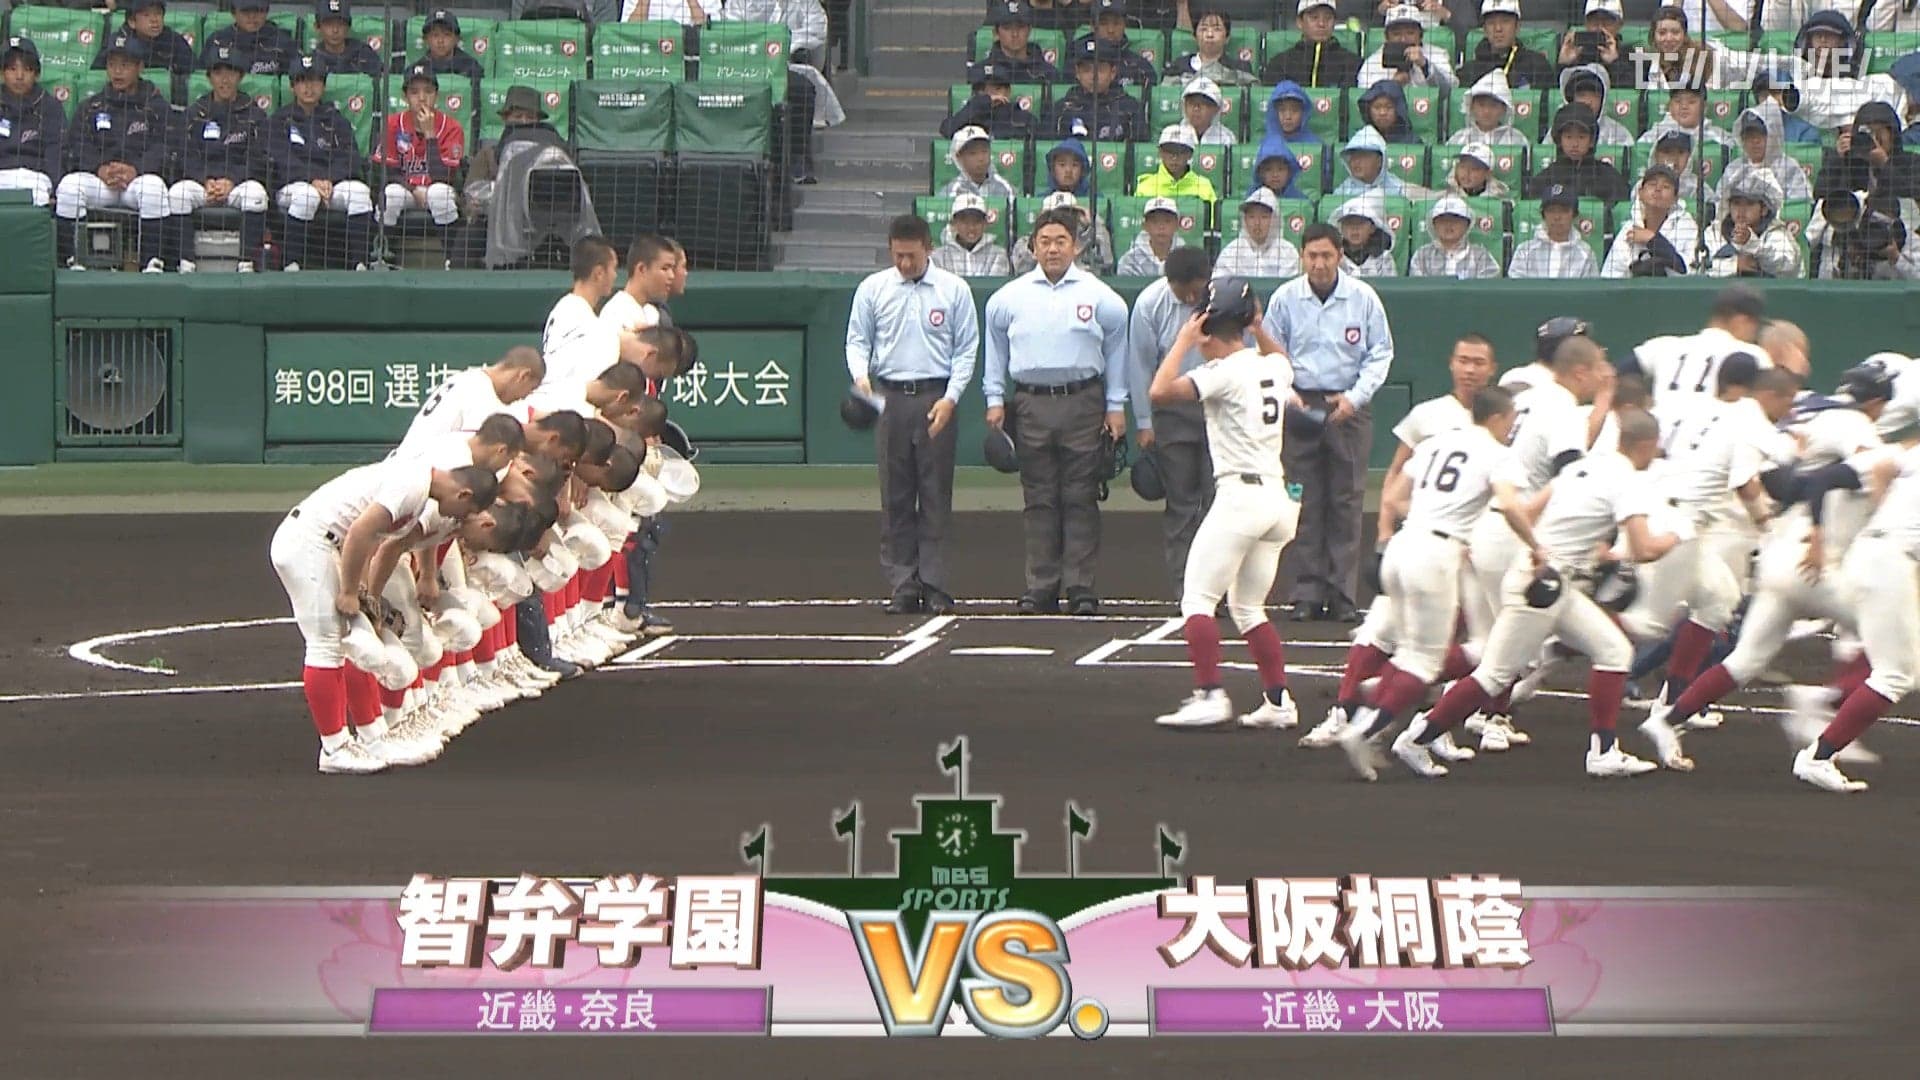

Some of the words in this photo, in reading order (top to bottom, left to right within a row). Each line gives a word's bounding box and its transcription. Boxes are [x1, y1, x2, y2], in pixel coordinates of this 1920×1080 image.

[274, 368, 374, 405] 第98回
[1668, 353, 1714, 392] 11
[1260, 379, 1279, 425] 5
[1420, 449, 1468, 492] 16
